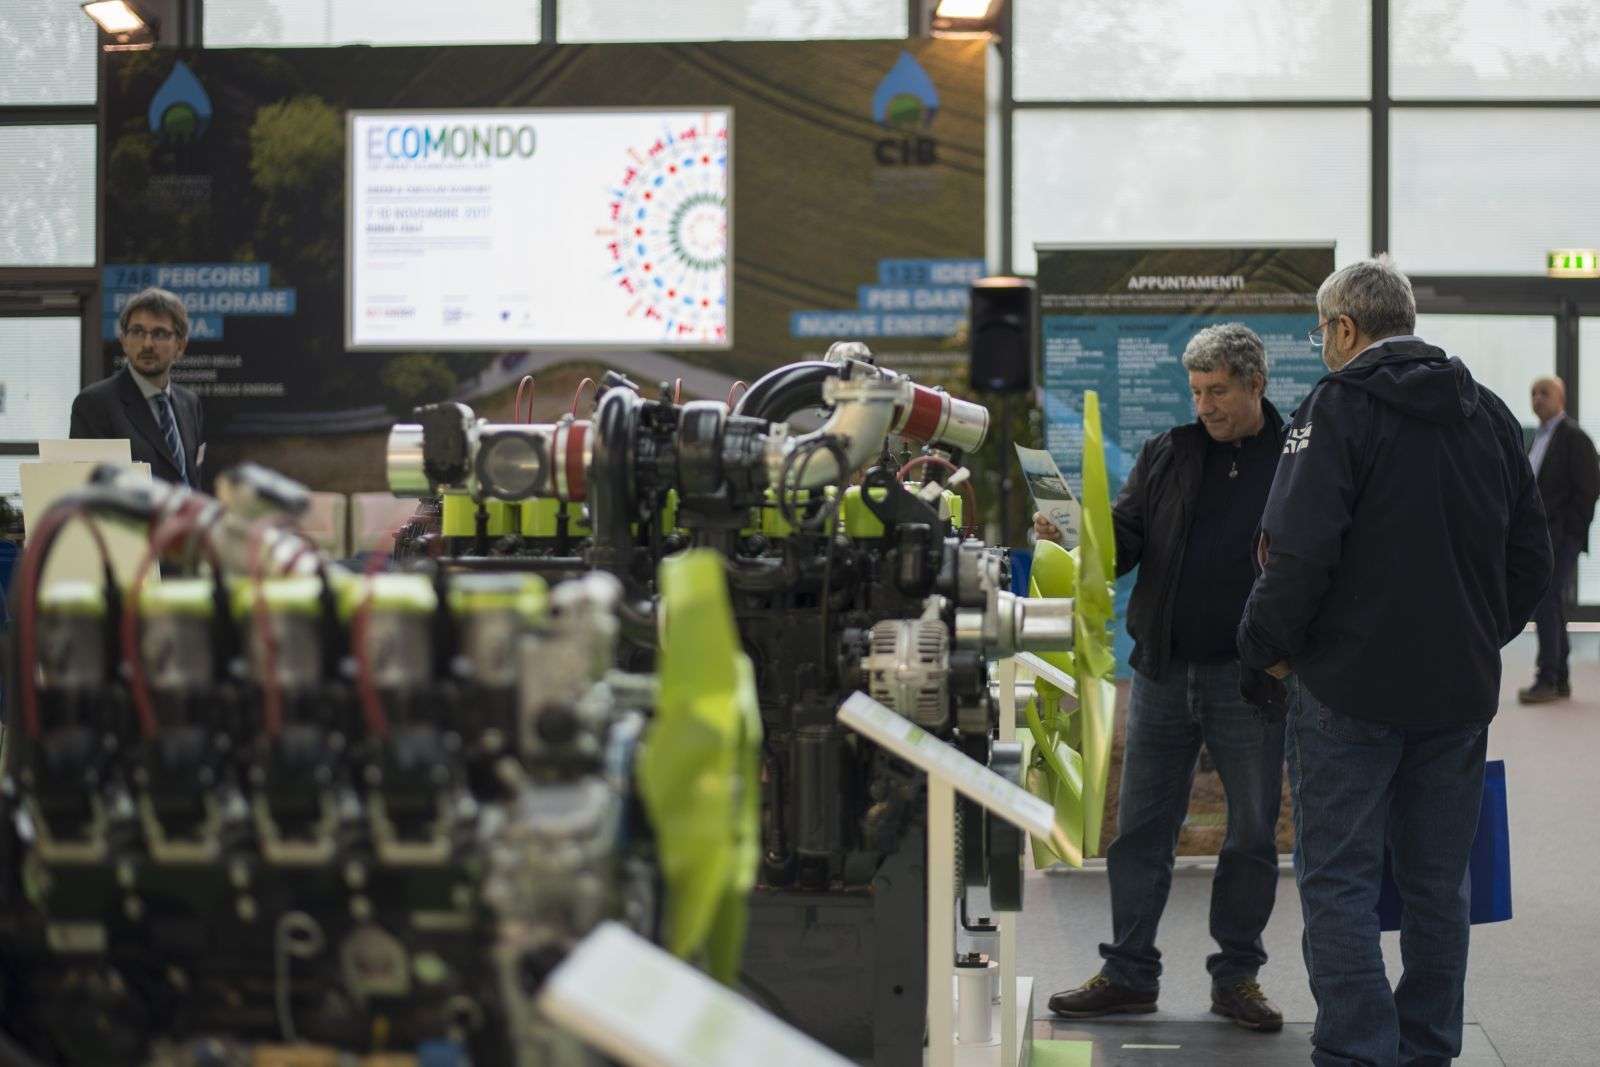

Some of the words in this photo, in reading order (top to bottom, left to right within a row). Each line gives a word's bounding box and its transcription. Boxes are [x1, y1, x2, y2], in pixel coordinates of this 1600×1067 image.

[367, 125, 537, 160] ECOMONDO
[874, 139, 936, 166] CIB
[157, 266, 261, 287] PERCORSI
[1127, 275, 1245, 290] APPUNTAMENTI
[867, 288, 911, 309] PER
[799, 314, 878, 336] NUOVE
